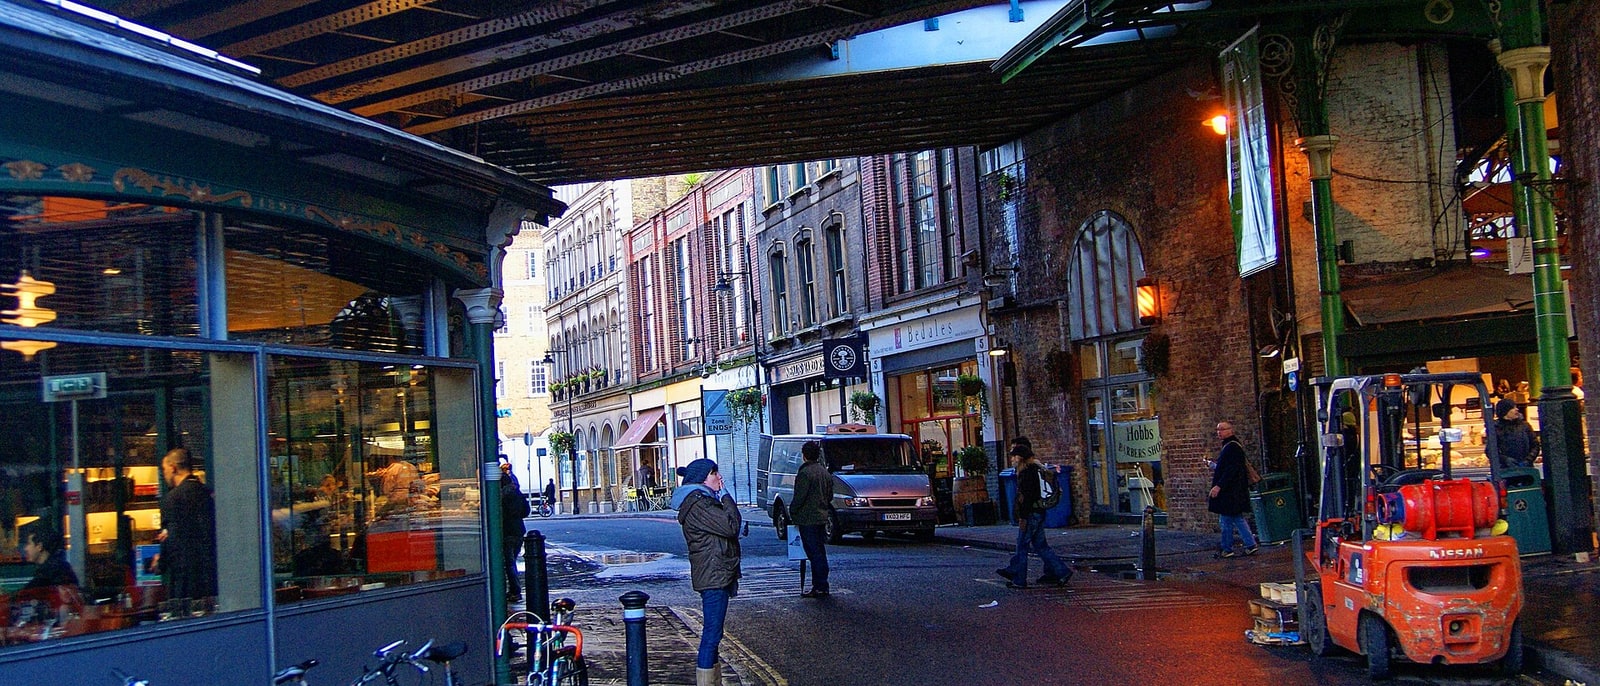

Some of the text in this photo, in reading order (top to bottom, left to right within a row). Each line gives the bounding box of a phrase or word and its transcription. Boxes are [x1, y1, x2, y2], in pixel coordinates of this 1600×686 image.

[907, 319, 953, 343] Bedales
[979, 338, 985, 349] 5
[708, 424, 729, 432] ENDS
[1126, 425, 1154, 442] Hobbs
[1429, 547, 1483, 559] NISSAN
